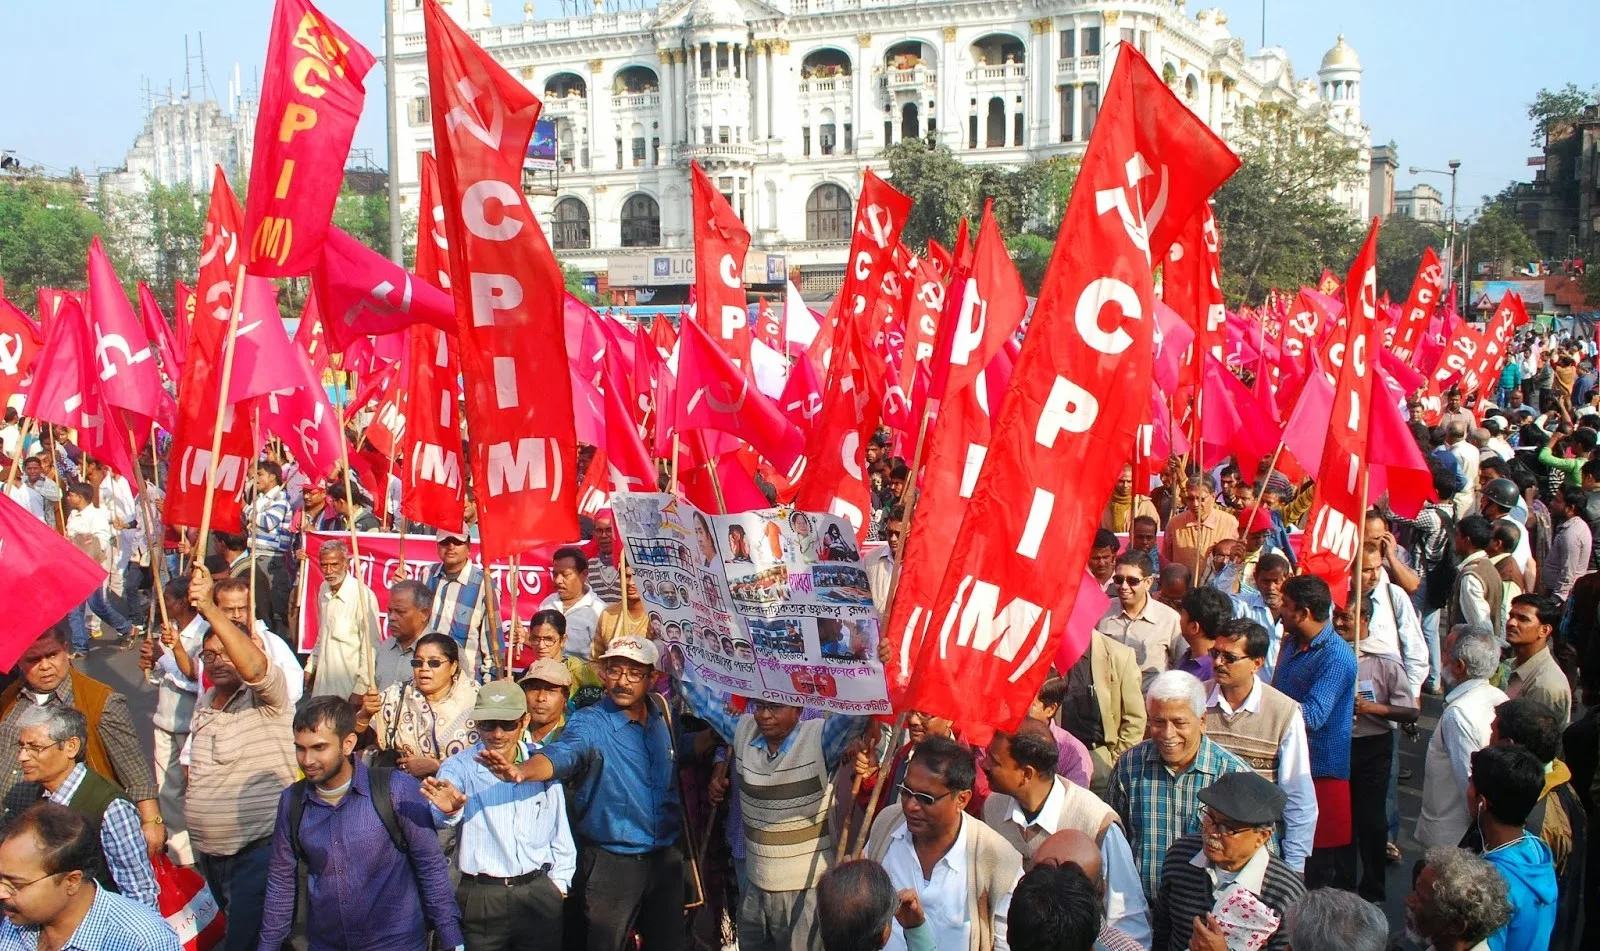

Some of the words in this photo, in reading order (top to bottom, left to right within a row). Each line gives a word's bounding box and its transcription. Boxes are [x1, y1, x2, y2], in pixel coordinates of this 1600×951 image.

[250, 57, 330, 266] CPI(M)
[674, 257, 693, 275] LIC
[940, 277, 1142, 683] CPI(M)
[761, 690, 804, 704] CPI(M)
